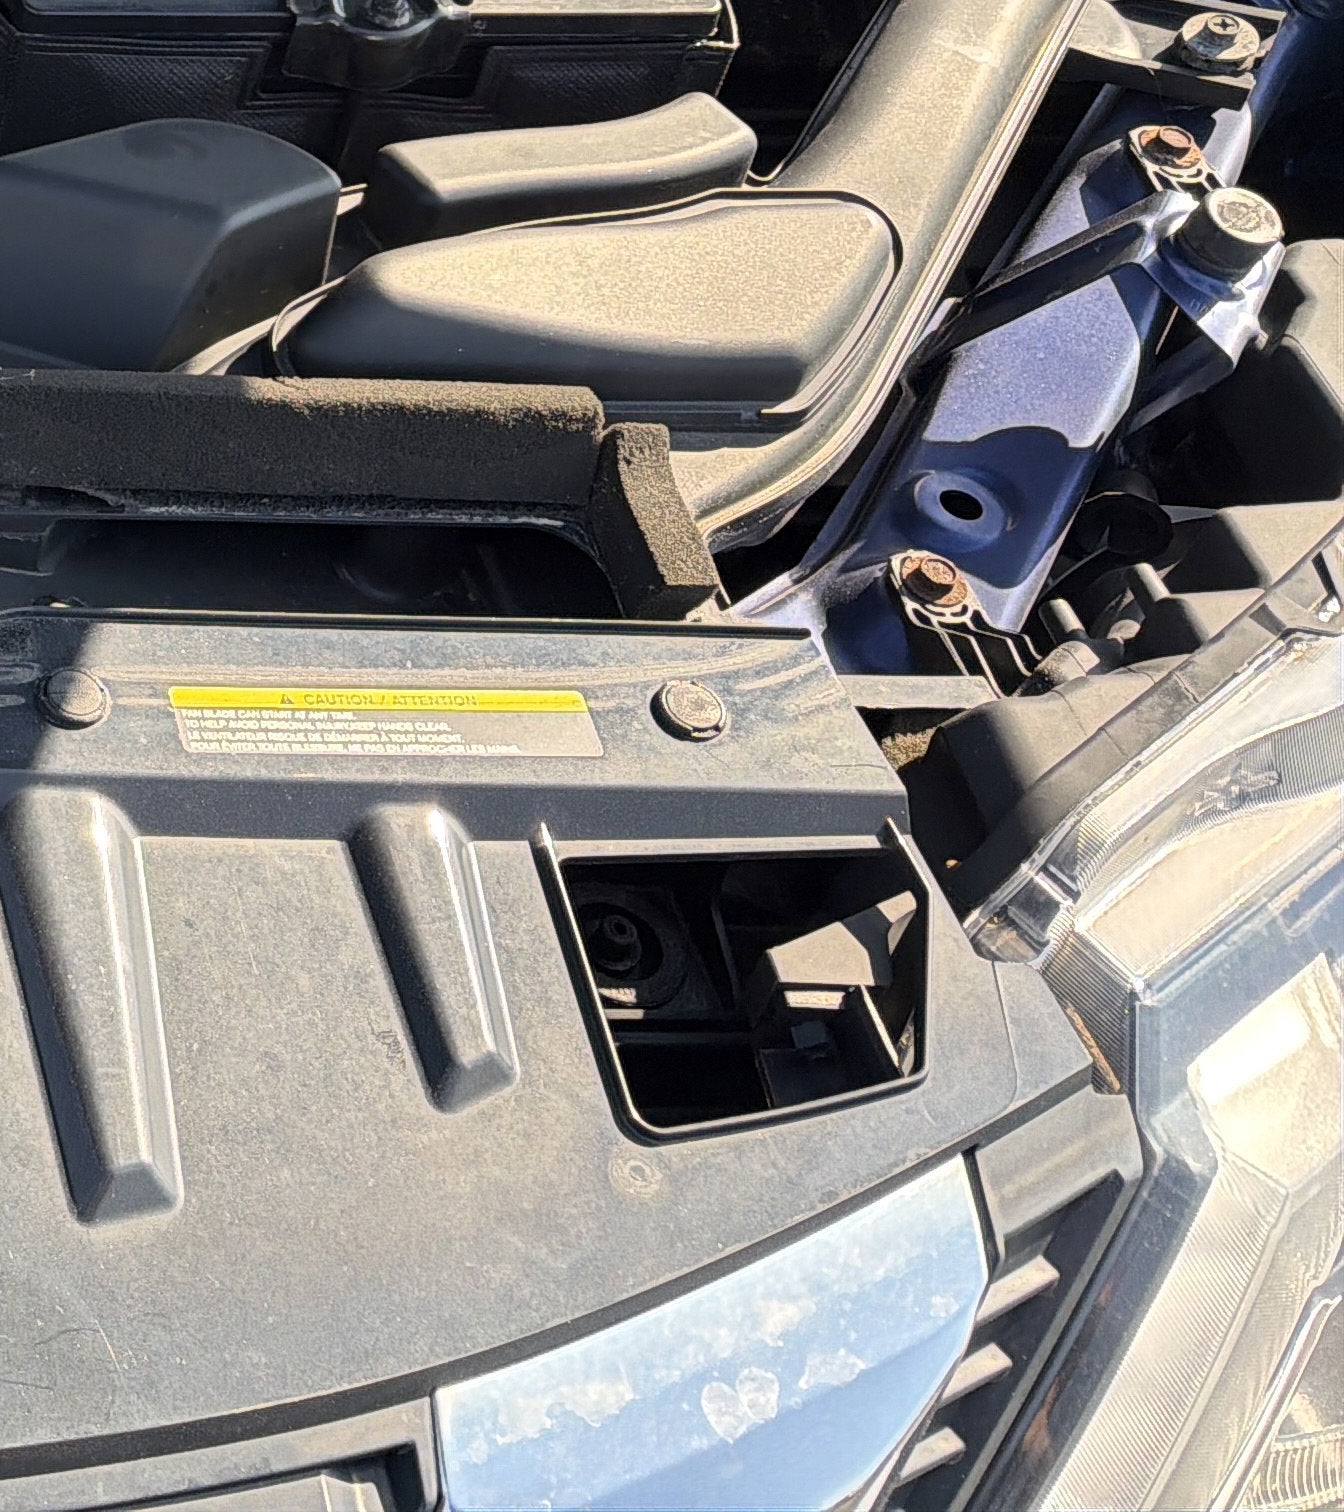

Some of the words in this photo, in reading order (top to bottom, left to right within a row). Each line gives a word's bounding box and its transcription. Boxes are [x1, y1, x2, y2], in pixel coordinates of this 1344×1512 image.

[305, 694, 374, 706] CAUTION
[392, 695, 477, 708] ATTENTION
[181, 709, 202, 718] FAN
[203, 709, 236, 718] BLADE
[238, 710, 260, 719] CAN
[185, 719, 199, 729] TO
[201, 720, 227, 729] HELP
[261, 720, 314, 730] PERSONAL
